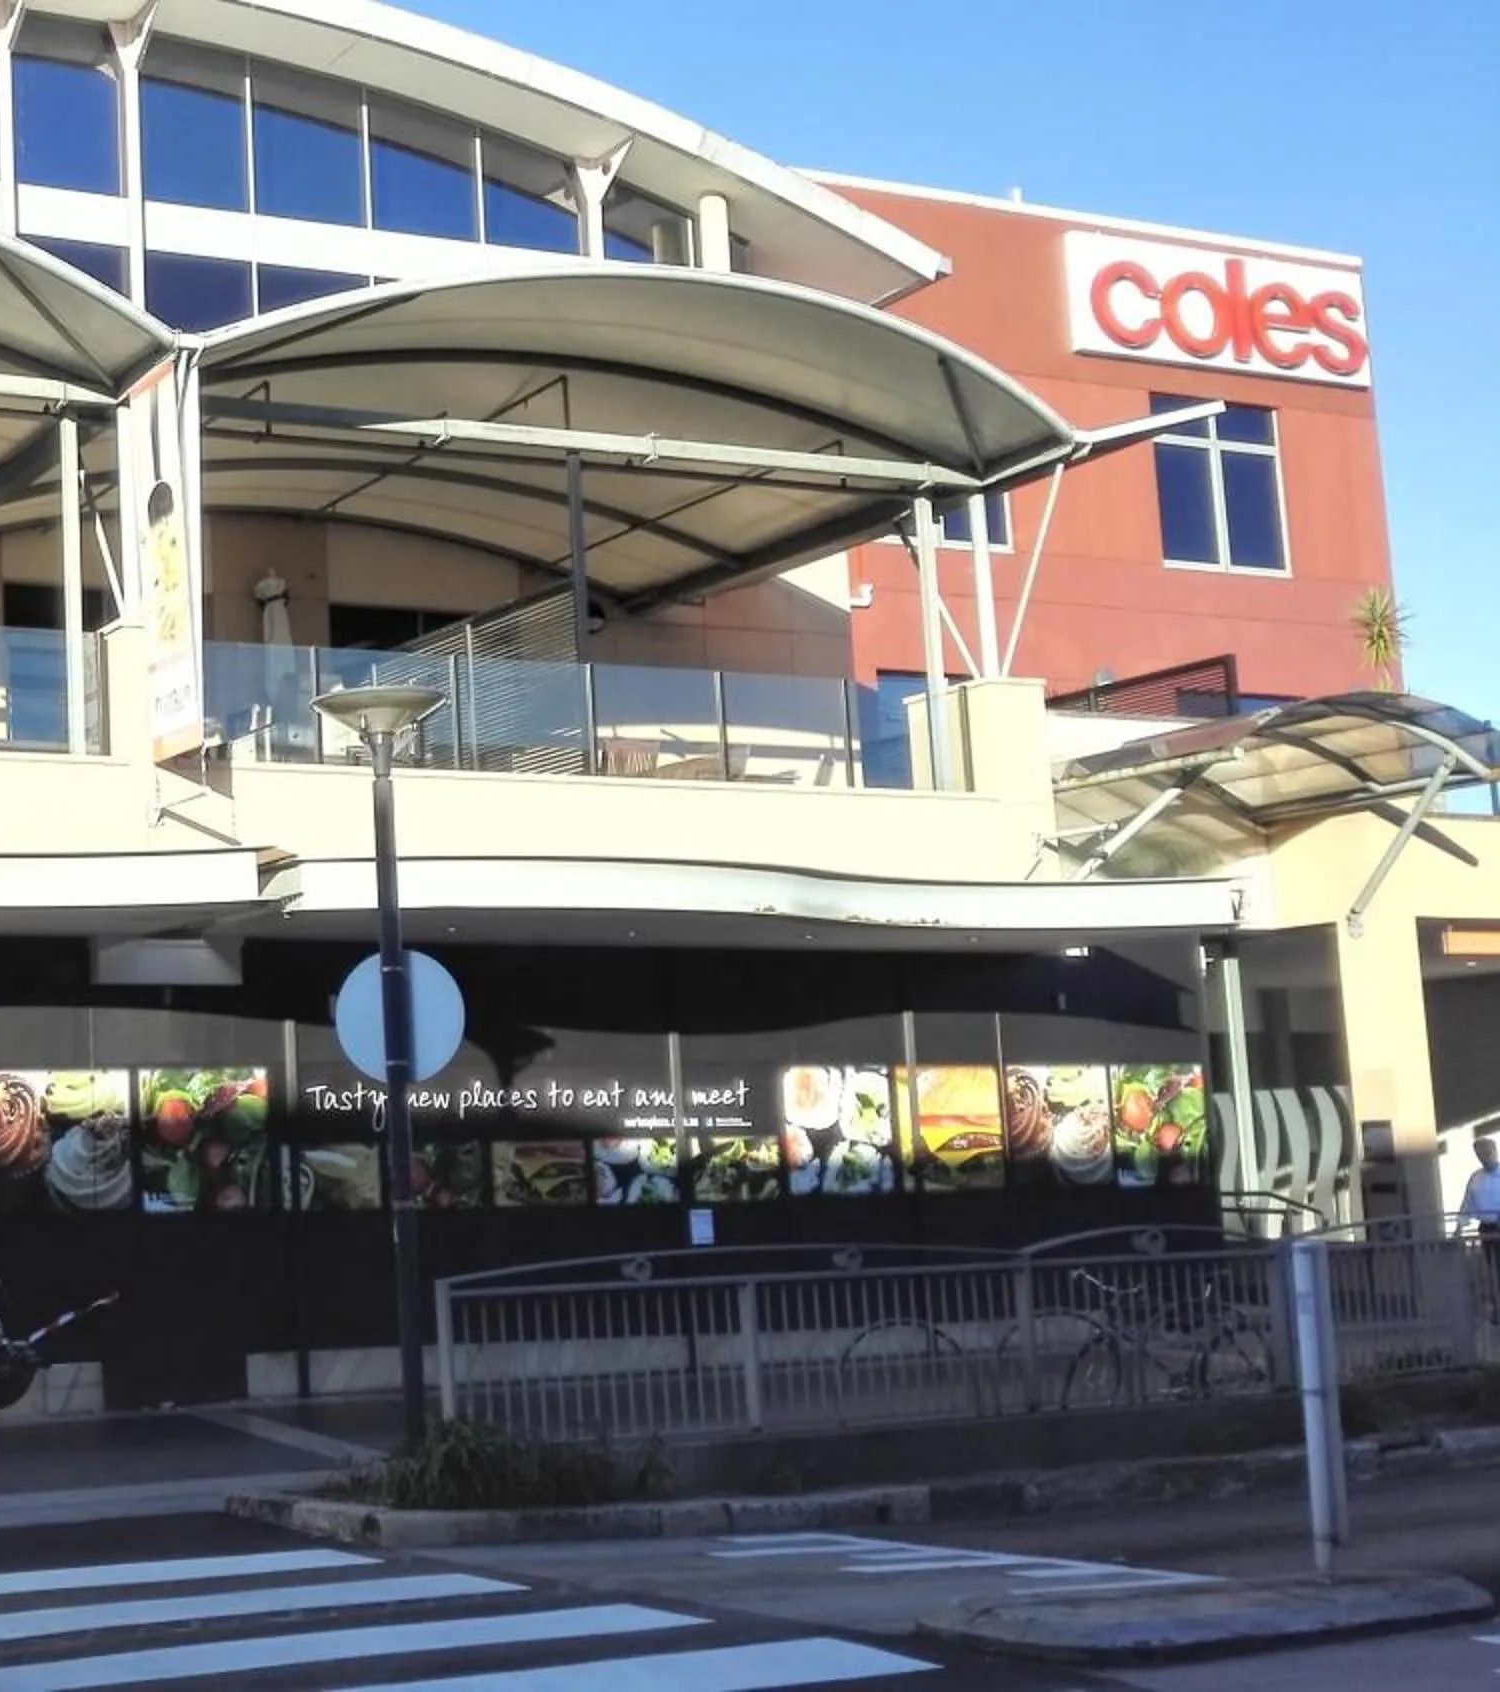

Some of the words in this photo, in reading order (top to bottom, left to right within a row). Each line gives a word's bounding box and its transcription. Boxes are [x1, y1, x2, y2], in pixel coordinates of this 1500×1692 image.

[1090, 258, 1369, 377] coles
[305, 1080, 388, 1132] Tasty
[459, 1079, 538, 1120] places
[547, 1080, 575, 1108] to
[583, 1080, 625, 1108] eat
[691, 1079, 751, 1107] meet
